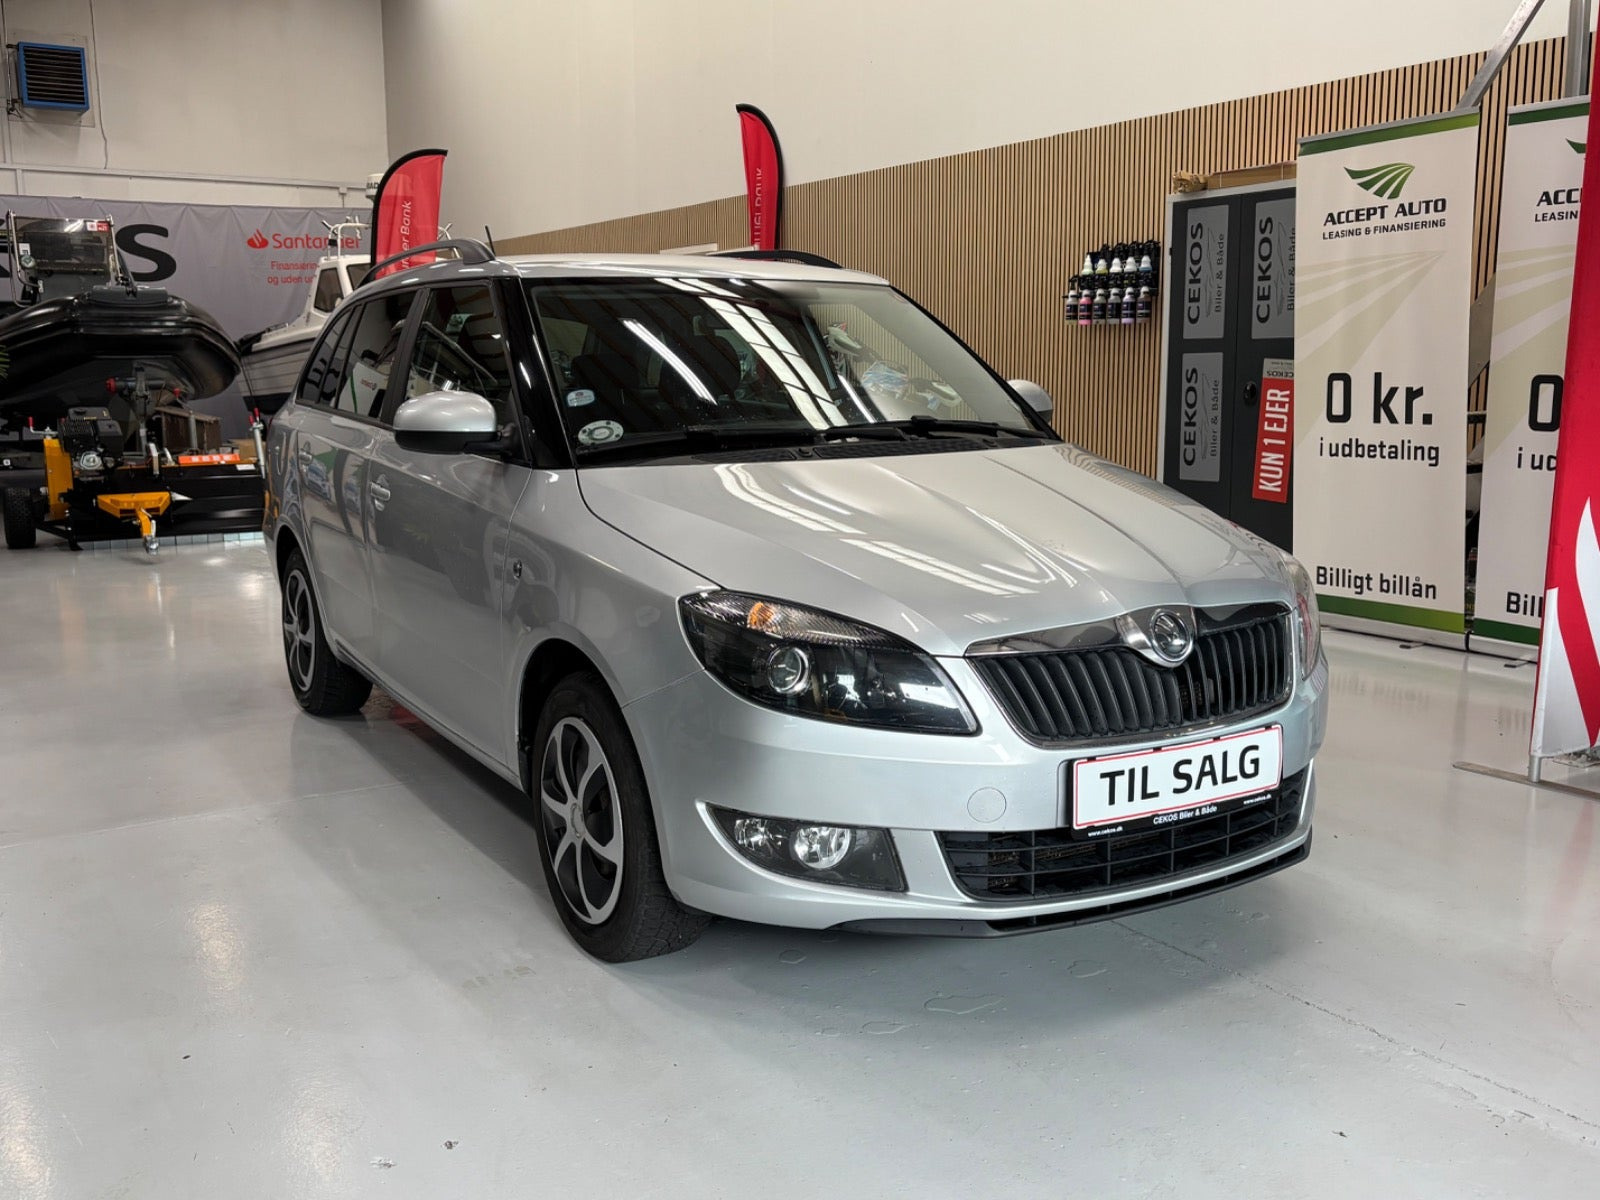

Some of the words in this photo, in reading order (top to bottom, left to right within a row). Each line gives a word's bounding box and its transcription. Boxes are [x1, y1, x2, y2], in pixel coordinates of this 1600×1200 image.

[1323, 204, 1389, 227] ACCEPT
[1394, 197, 1447, 218] AUTO
[1536, 187, 1583, 207] ACC
[400, 200, 412, 235] Bank
[1322, 227, 1362, 241] LEASING
[1364, 226, 1371, 236] &
[1373, 217, 1446, 235] FINANSIERING
[1216, 233, 1225, 265] Både
[1187, 222, 1203, 324] CEKOS
[1256, 216, 1274, 323] CEKOS
[1287, 282, 1295, 310] Biler
[1211, 379, 1220, 411] Både
[1263, 388, 1291, 433] EJER
[1326, 372, 1351, 424] 0
[1373, 372, 1433, 425] kr.
[1528, 374, 1564, 432] 0
[1183, 367, 1198, 466] CEKOS
[1210, 430, 1218, 457] Biler
[1263, 437, 1286, 446] 1
[1319, 437, 1324, 456] i
[1328, 438, 1440, 467] udbetaling
[1517, 446, 1523, 469] i
[1258, 452, 1285, 492] KUN
[1316, 566, 1373, 595] Billigt
[1379, 573, 1437, 600] billån
[1099, 764, 1159, 806] TIL
[1172, 744, 1260, 794] SALG
[1153, 812, 1178, 825] CEKOS
[1179, 809, 1194, 821] Biler
[1201, 805, 1217, 815] Både
